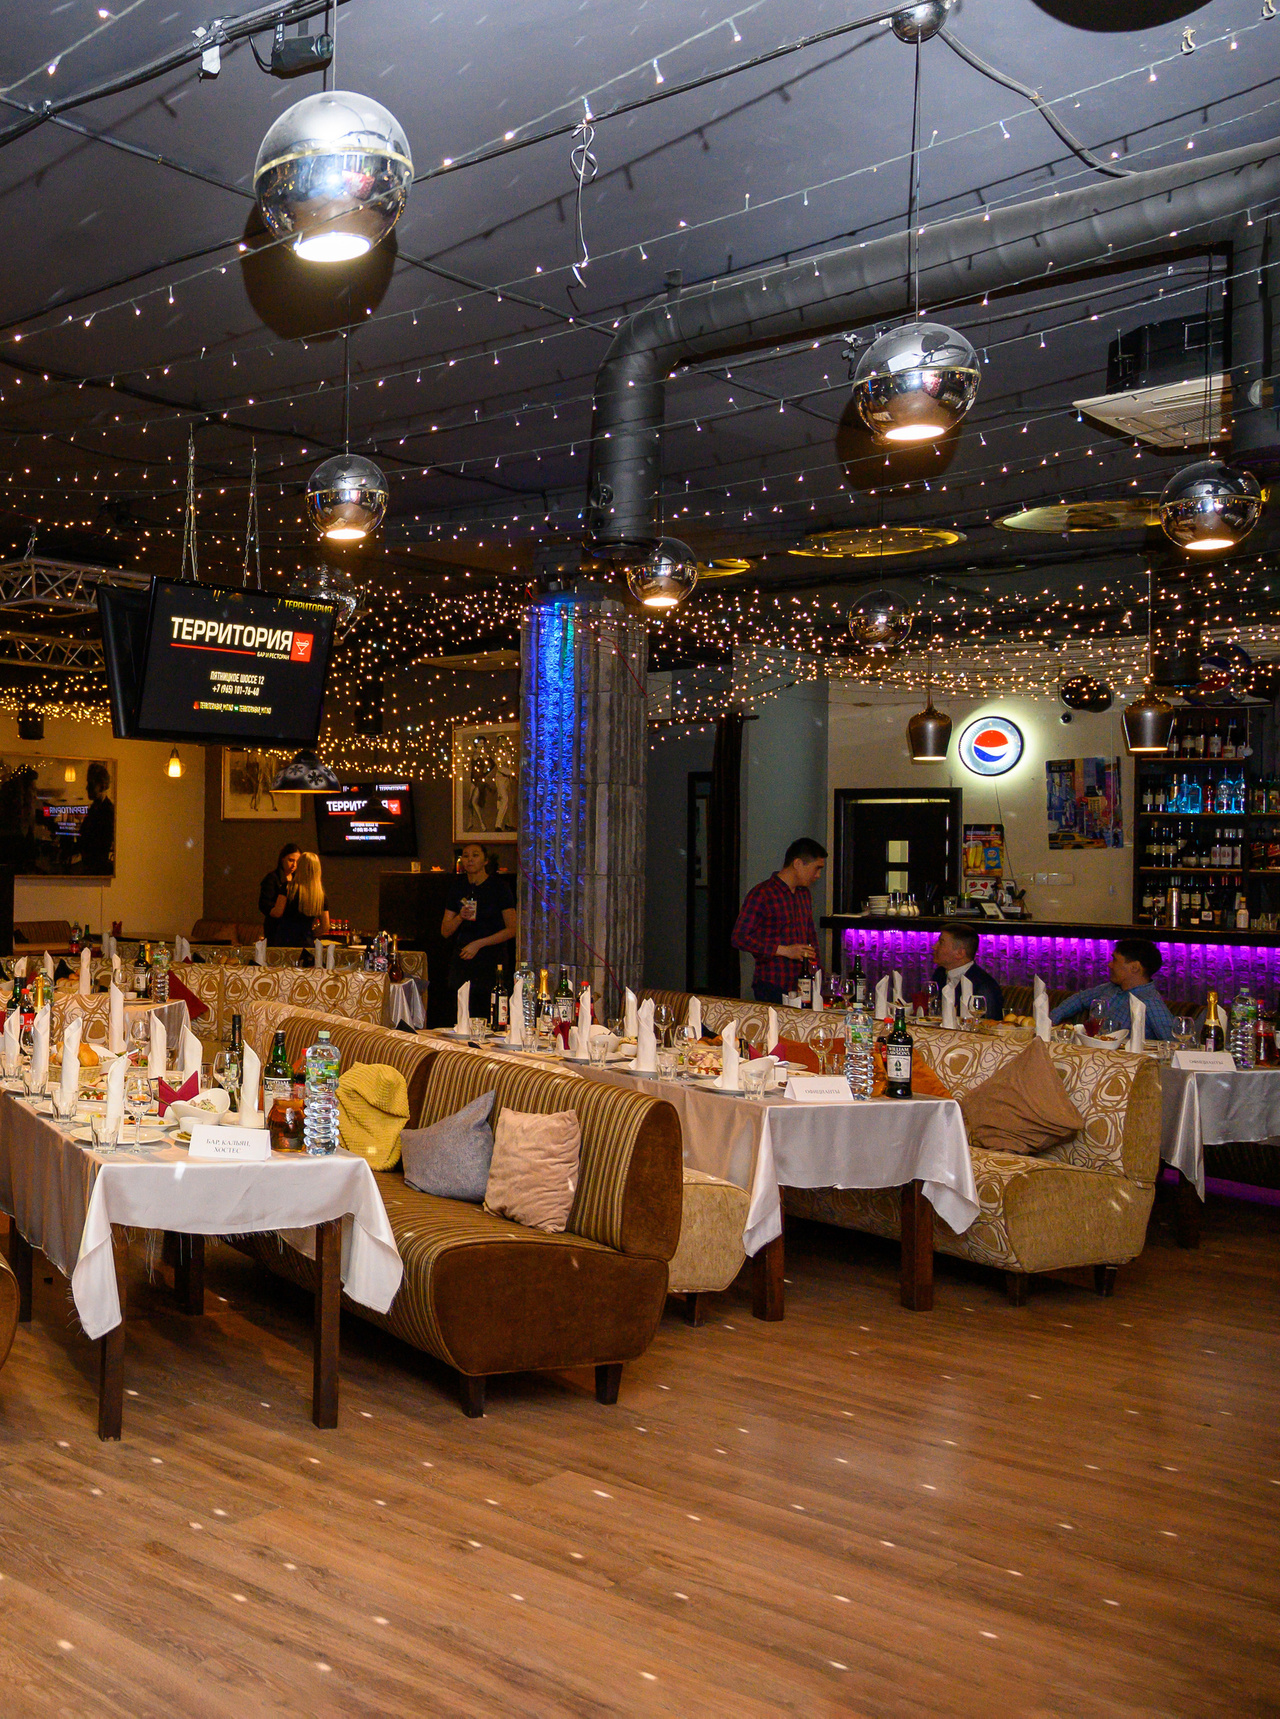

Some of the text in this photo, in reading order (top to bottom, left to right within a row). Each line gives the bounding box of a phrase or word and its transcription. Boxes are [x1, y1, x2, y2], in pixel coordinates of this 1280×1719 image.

[170, 616, 294, 652] ТЕРРИТОРИЯ
[258, 675, 265, 685] 12
[326, 800, 389, 812] ТЕРРИТЯ
[213, 1146, 242, 1155] ХОСТЕС
